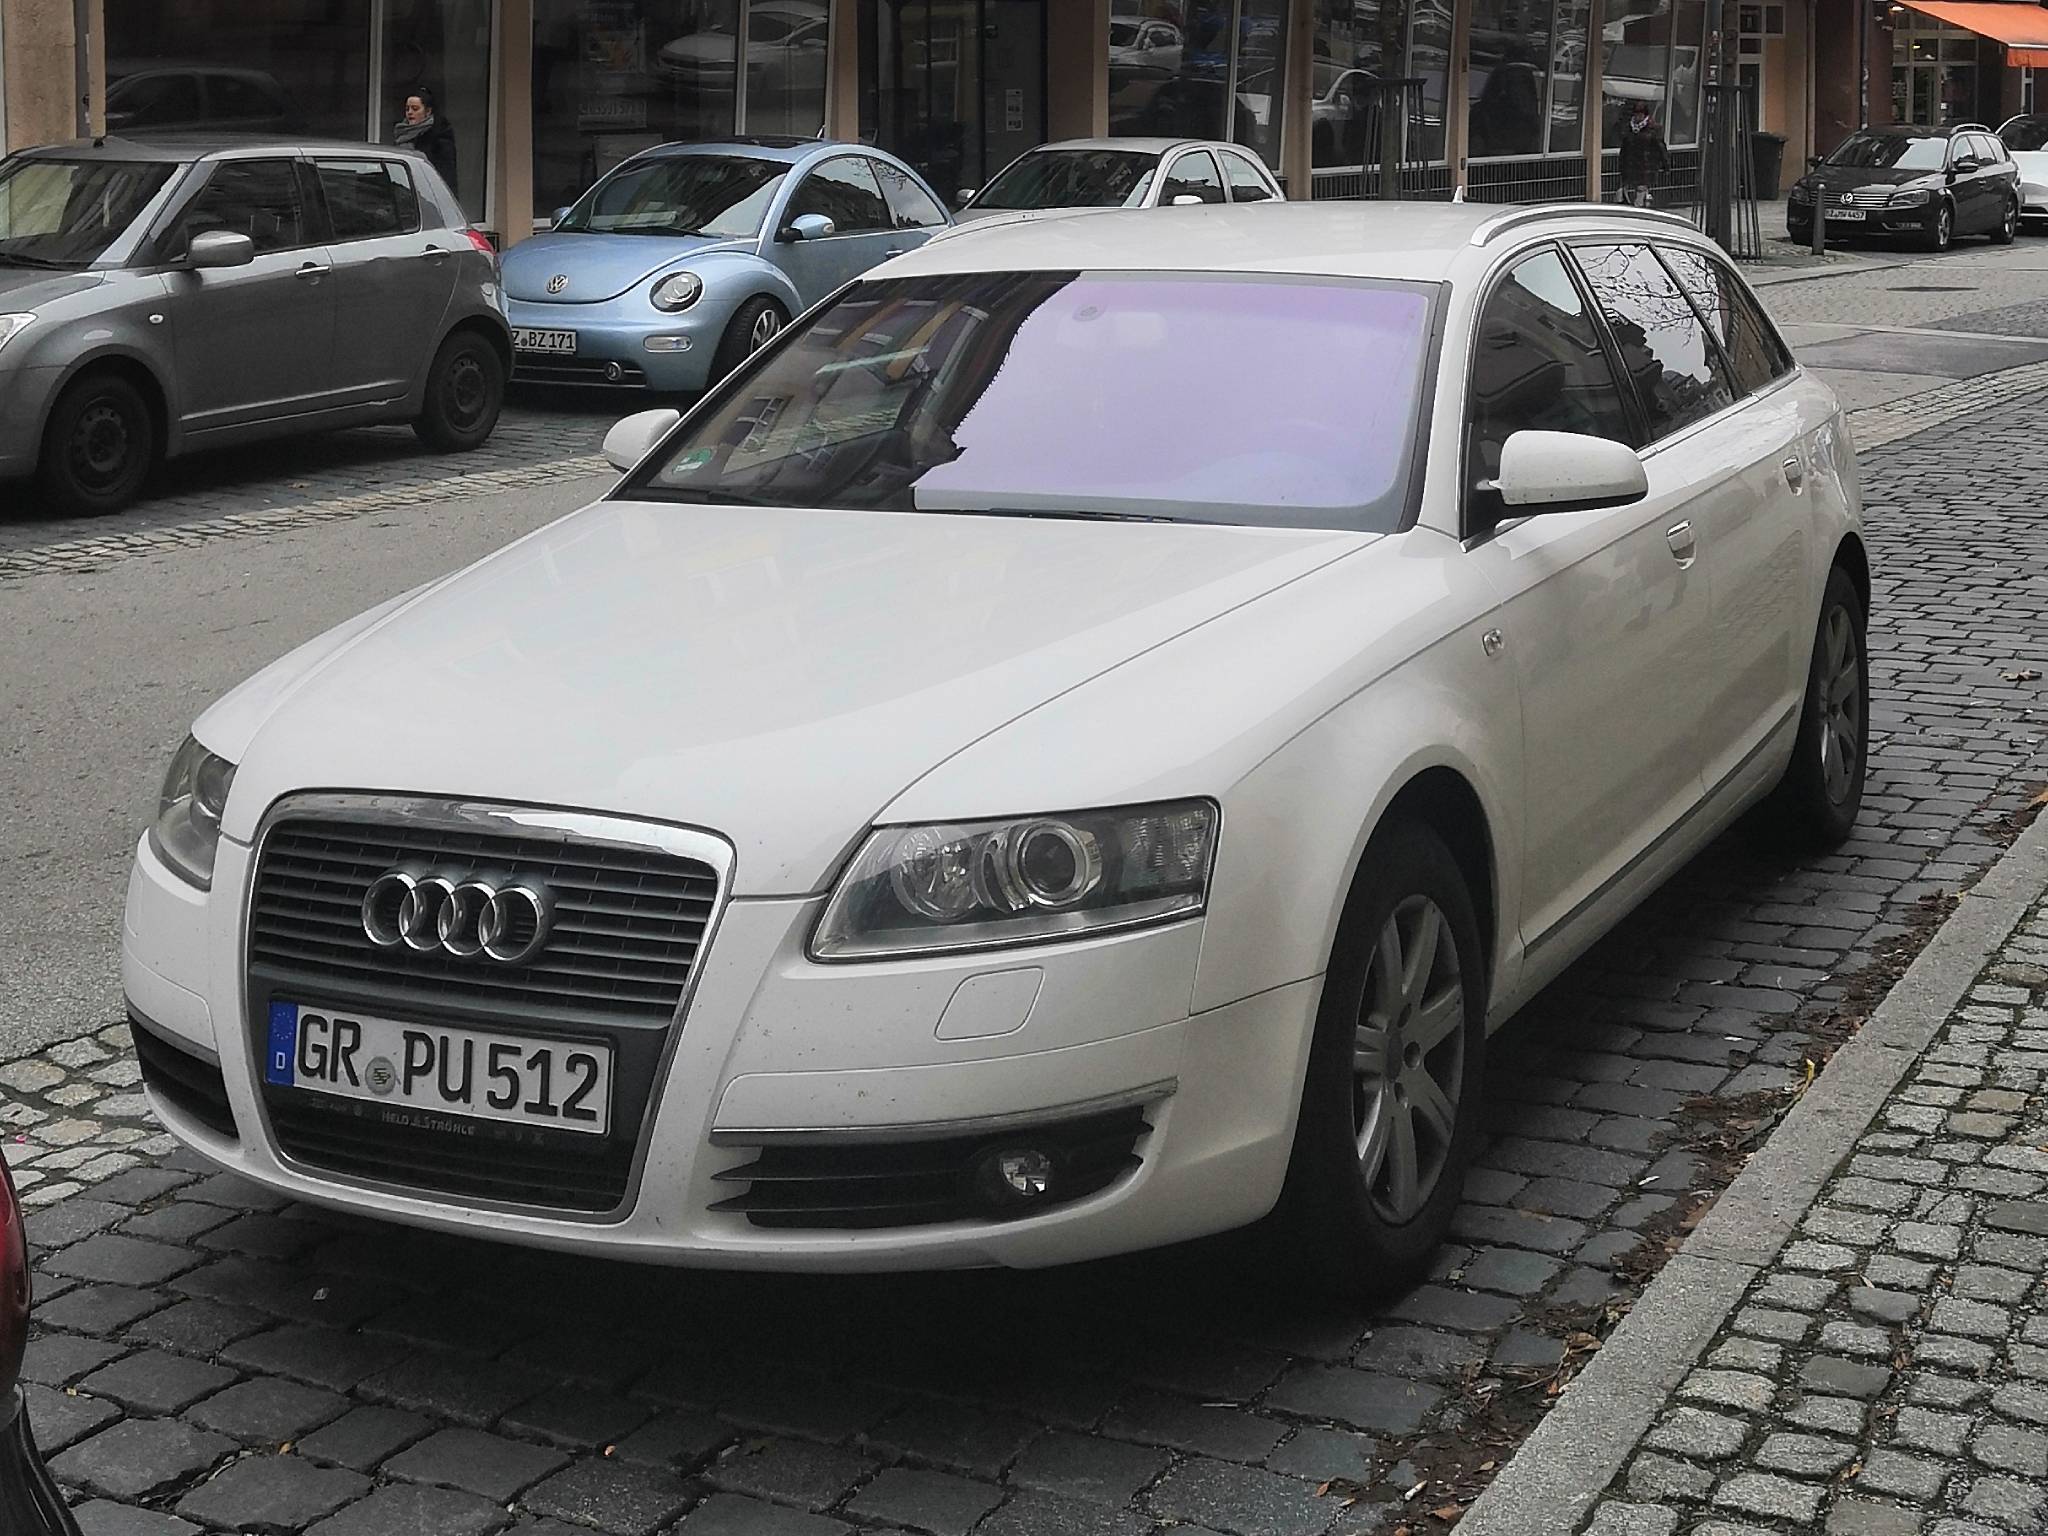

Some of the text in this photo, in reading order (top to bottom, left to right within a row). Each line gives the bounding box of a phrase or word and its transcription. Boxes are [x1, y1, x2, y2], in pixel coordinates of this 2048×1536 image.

[529, 331, 547, 348] BZ
[549, 333, 575, 349] 171
[275, 1051, 287, 1070] D
[298, 1012, 600, 1122] GR PU 512
